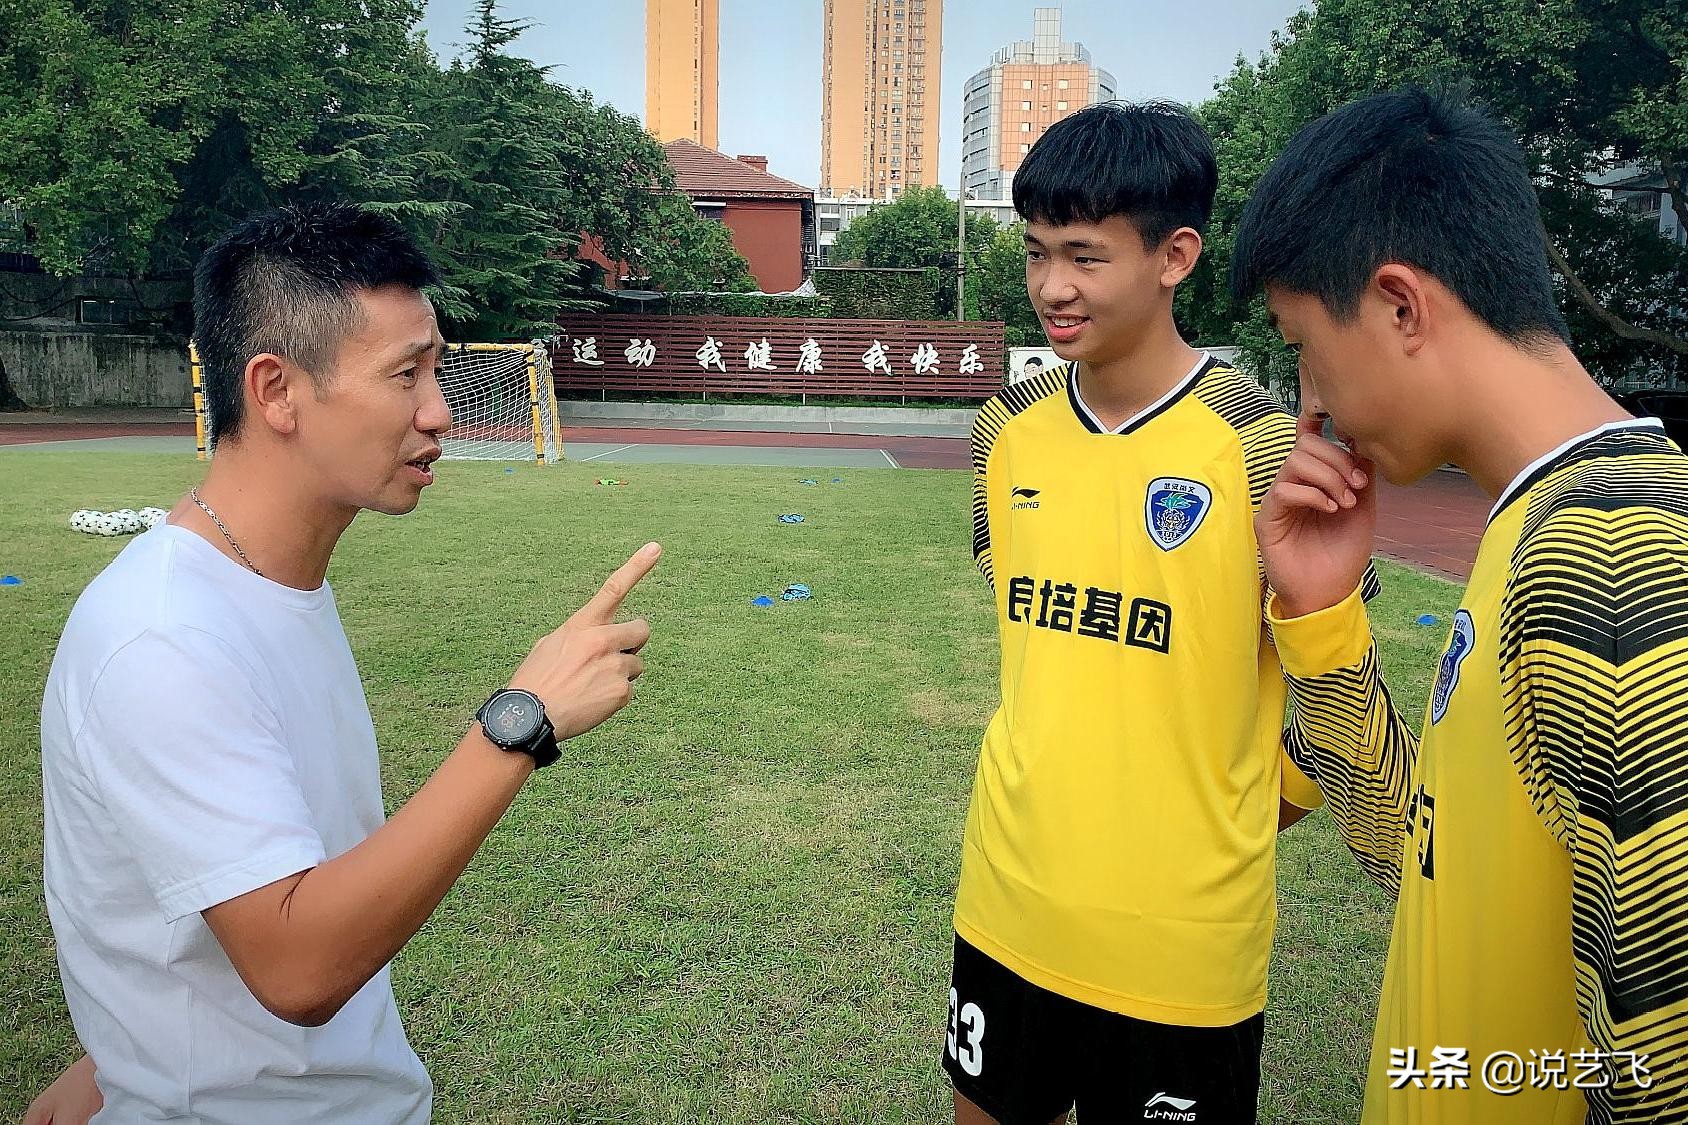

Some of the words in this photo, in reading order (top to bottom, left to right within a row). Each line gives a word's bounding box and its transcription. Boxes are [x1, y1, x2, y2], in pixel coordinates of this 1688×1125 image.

[695, 336, 824, 375] 我健康
[861, 339, 985, 376] 我快乐
[1011, 501, 1040, 511] I-NING
[1143, 1109, 1197, 1122] LI-NING
